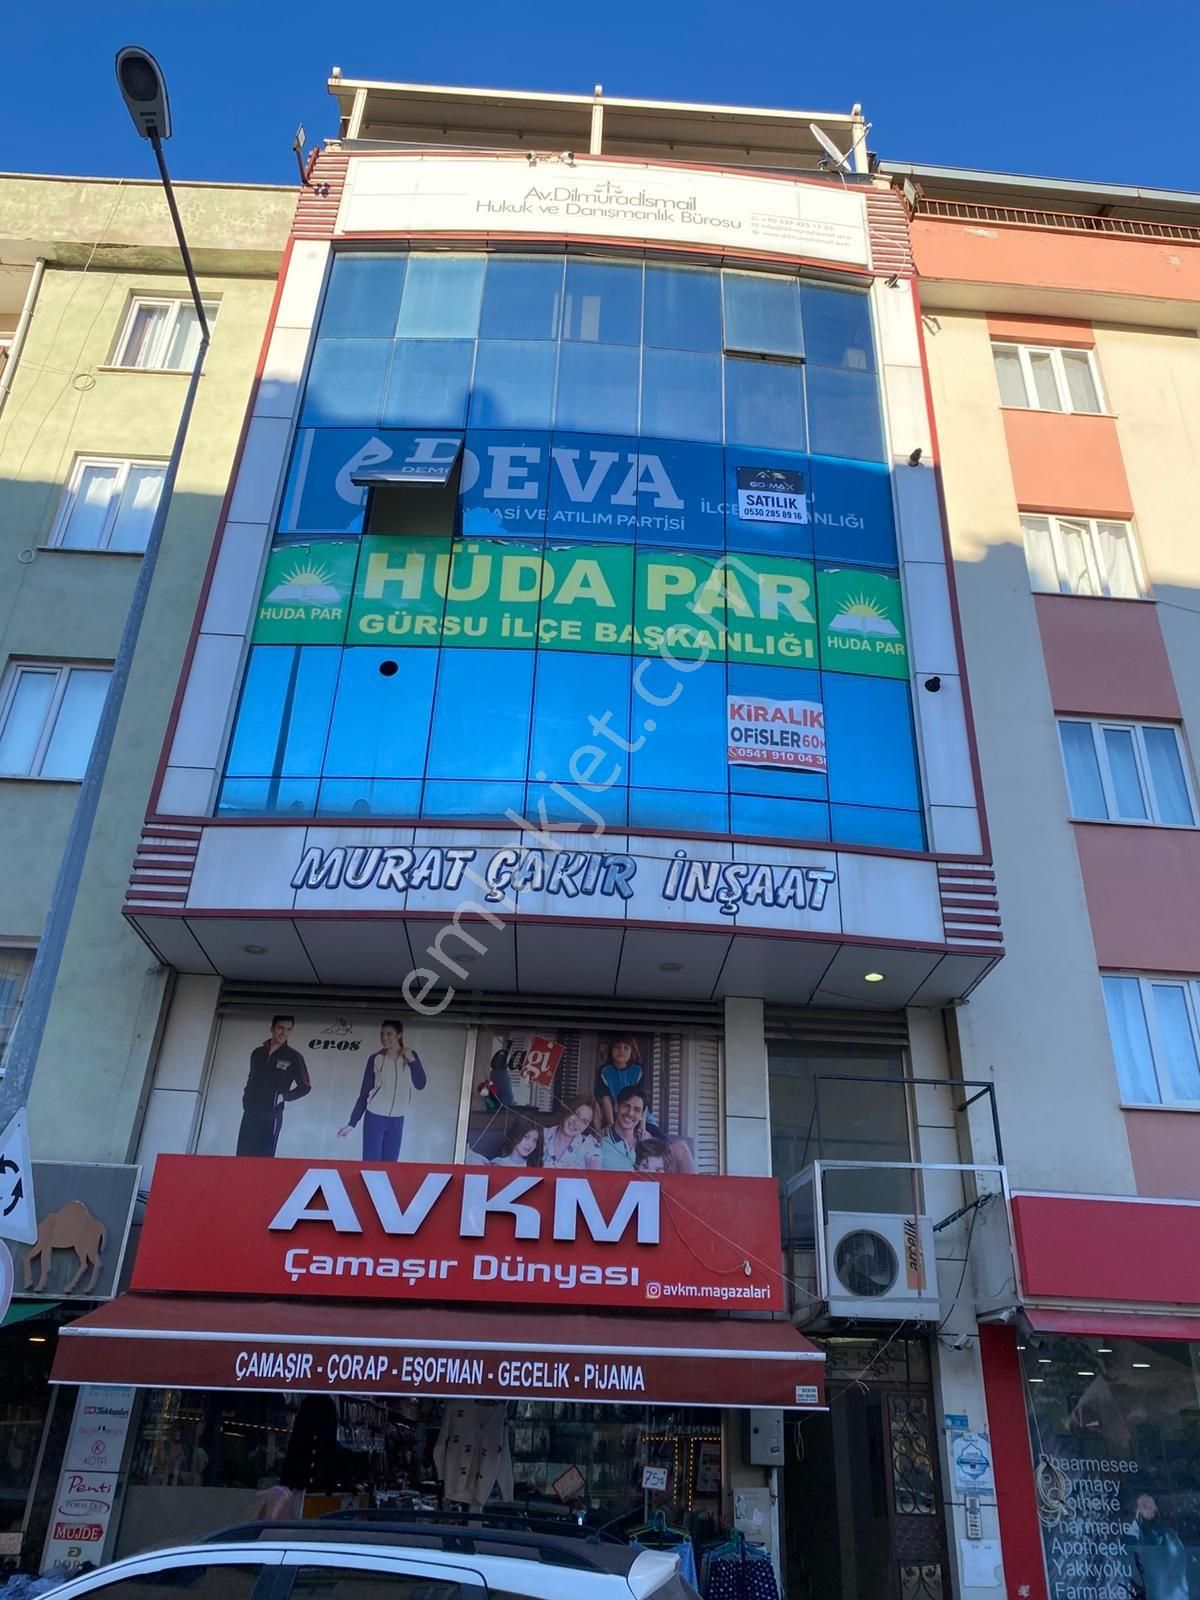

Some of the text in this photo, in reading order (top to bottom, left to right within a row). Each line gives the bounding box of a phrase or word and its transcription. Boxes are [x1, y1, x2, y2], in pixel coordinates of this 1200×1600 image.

[476, 200, 533, 213] Hukuk
[538, 205, 560, 214] ve
[681, 211, 741, 229] Bürosu
[746, 495, 798, 509] SATILIK
[524, 508, 549, 520] VE
[552, 510, 613, 525] ATILIM
[617, 514, 685, 530] PARTİSİ
[744, 508, 802, 520] 0530 285 89 16
[364, 544, 816, 623] HÜDA PAR
[311, 608, 342, 620] PAR
[359, 611, 814, 658] GÜRSU İLÇE BAŞKANLIĞI
[876, 641, 905, 655] PAR
[739, 748, 768, 758] 0541
[772, 750, 794, 760] 910
[798, 754, 812, 763] 04
[290, 846, 836, 915] MURAT ÇAKIR İNŞAAT
[308, 1038, 361, 1050] eros
[268, 1168, 660, 1244] AVKM
[284, 1248, 639, 1288] Çamaşır Dünyası
[663, 1283, 771, 1300] avkm.magazalari
[235, 1351, 313, 1382] ÇAMAŞIR
[327, 1354, 389, 1383] ÇORAP
[401, 1356, 484, 1386] EŞOFMAN
[68, 1475, 112, 1494] Penti
[1051, 1537, 1128, 1559] Apotheek
